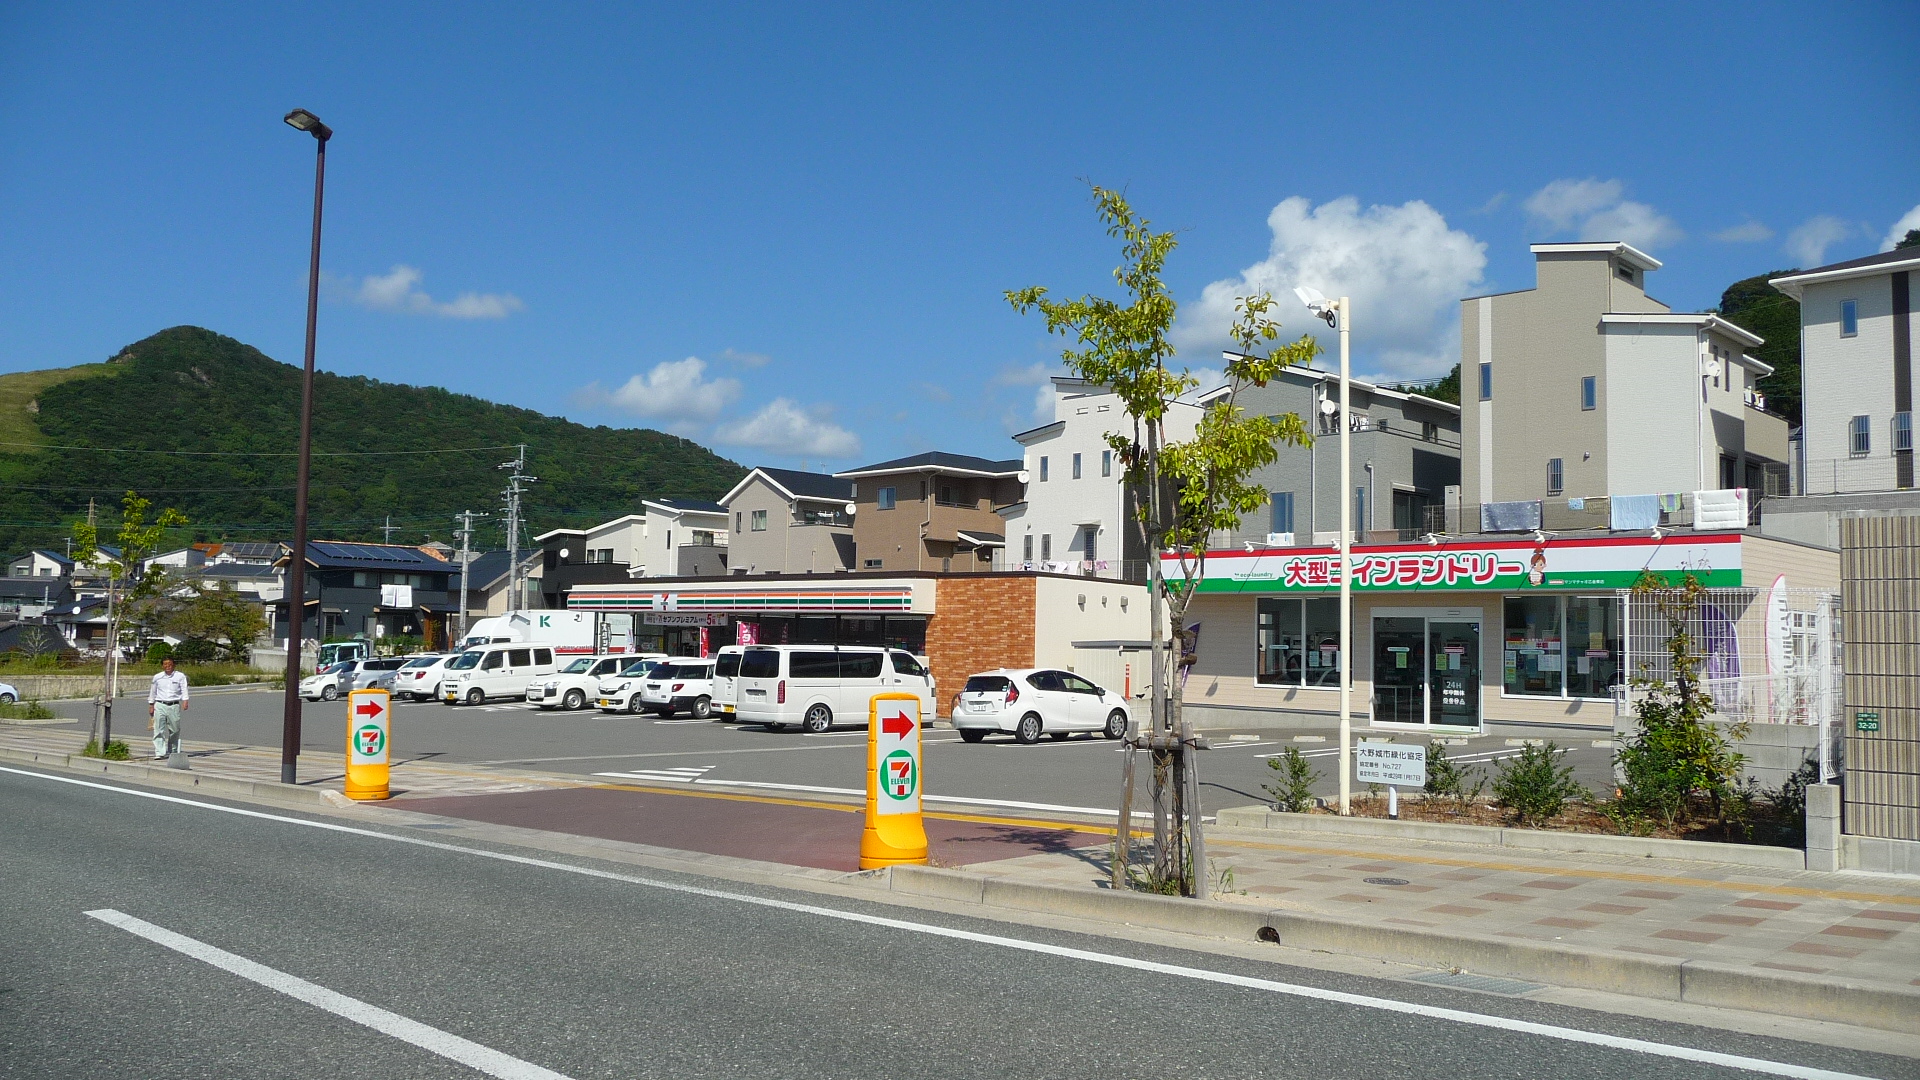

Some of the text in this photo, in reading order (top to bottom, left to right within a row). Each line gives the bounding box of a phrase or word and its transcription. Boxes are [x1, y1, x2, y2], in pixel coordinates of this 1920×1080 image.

[1286, 557, 1521, 585] 大型コインランドリー
[1446, 681, 1462, 689] 24H
[1359, 748, 1423, 761] 大野城市緑化協定
